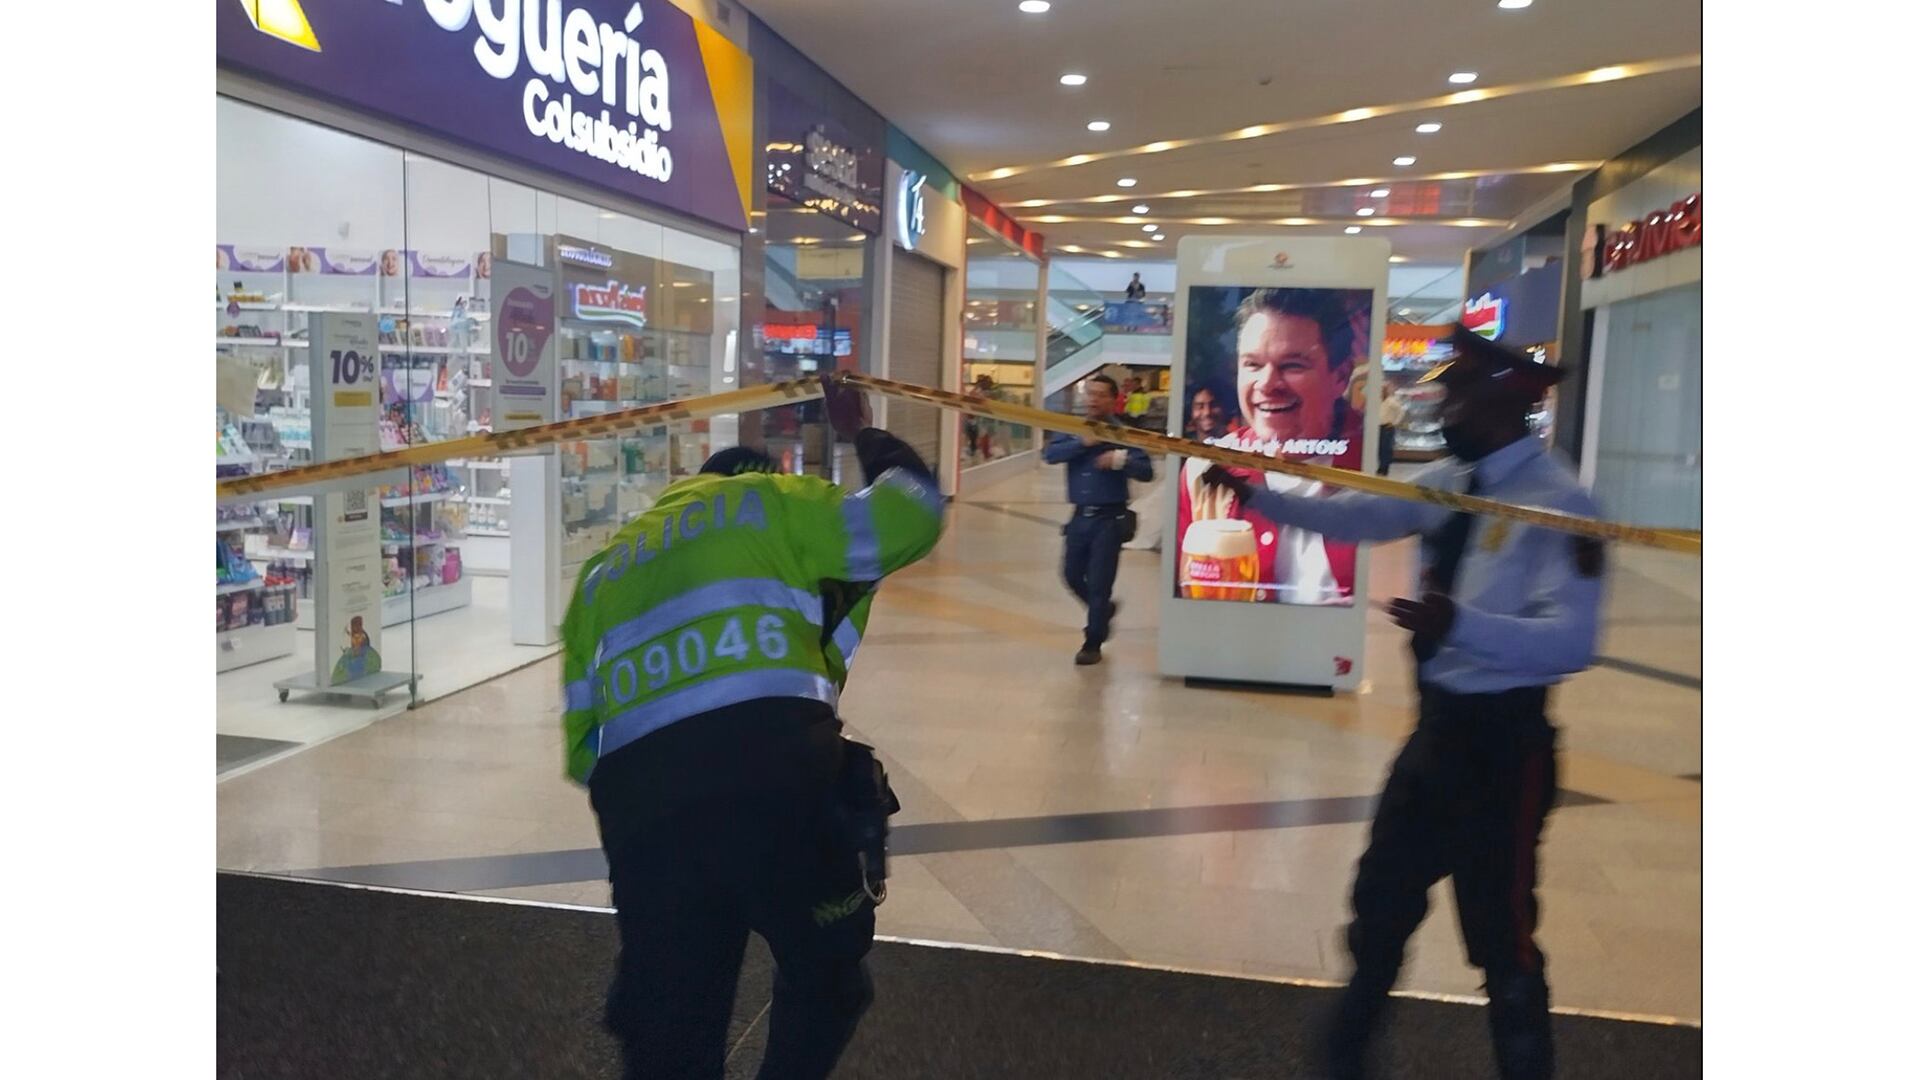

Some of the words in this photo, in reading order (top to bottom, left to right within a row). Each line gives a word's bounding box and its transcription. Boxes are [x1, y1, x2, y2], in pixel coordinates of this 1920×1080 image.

[384, 0, 672, 132] guería
[523, 78, 673, 182] Colsubsidio
[330, 350, 374, 384] 10%
[1281, 438, 1350, 456] ARTOIS
[583, 490, 769, 605] POLICIA
[602, 613, 790, 704] 09046
